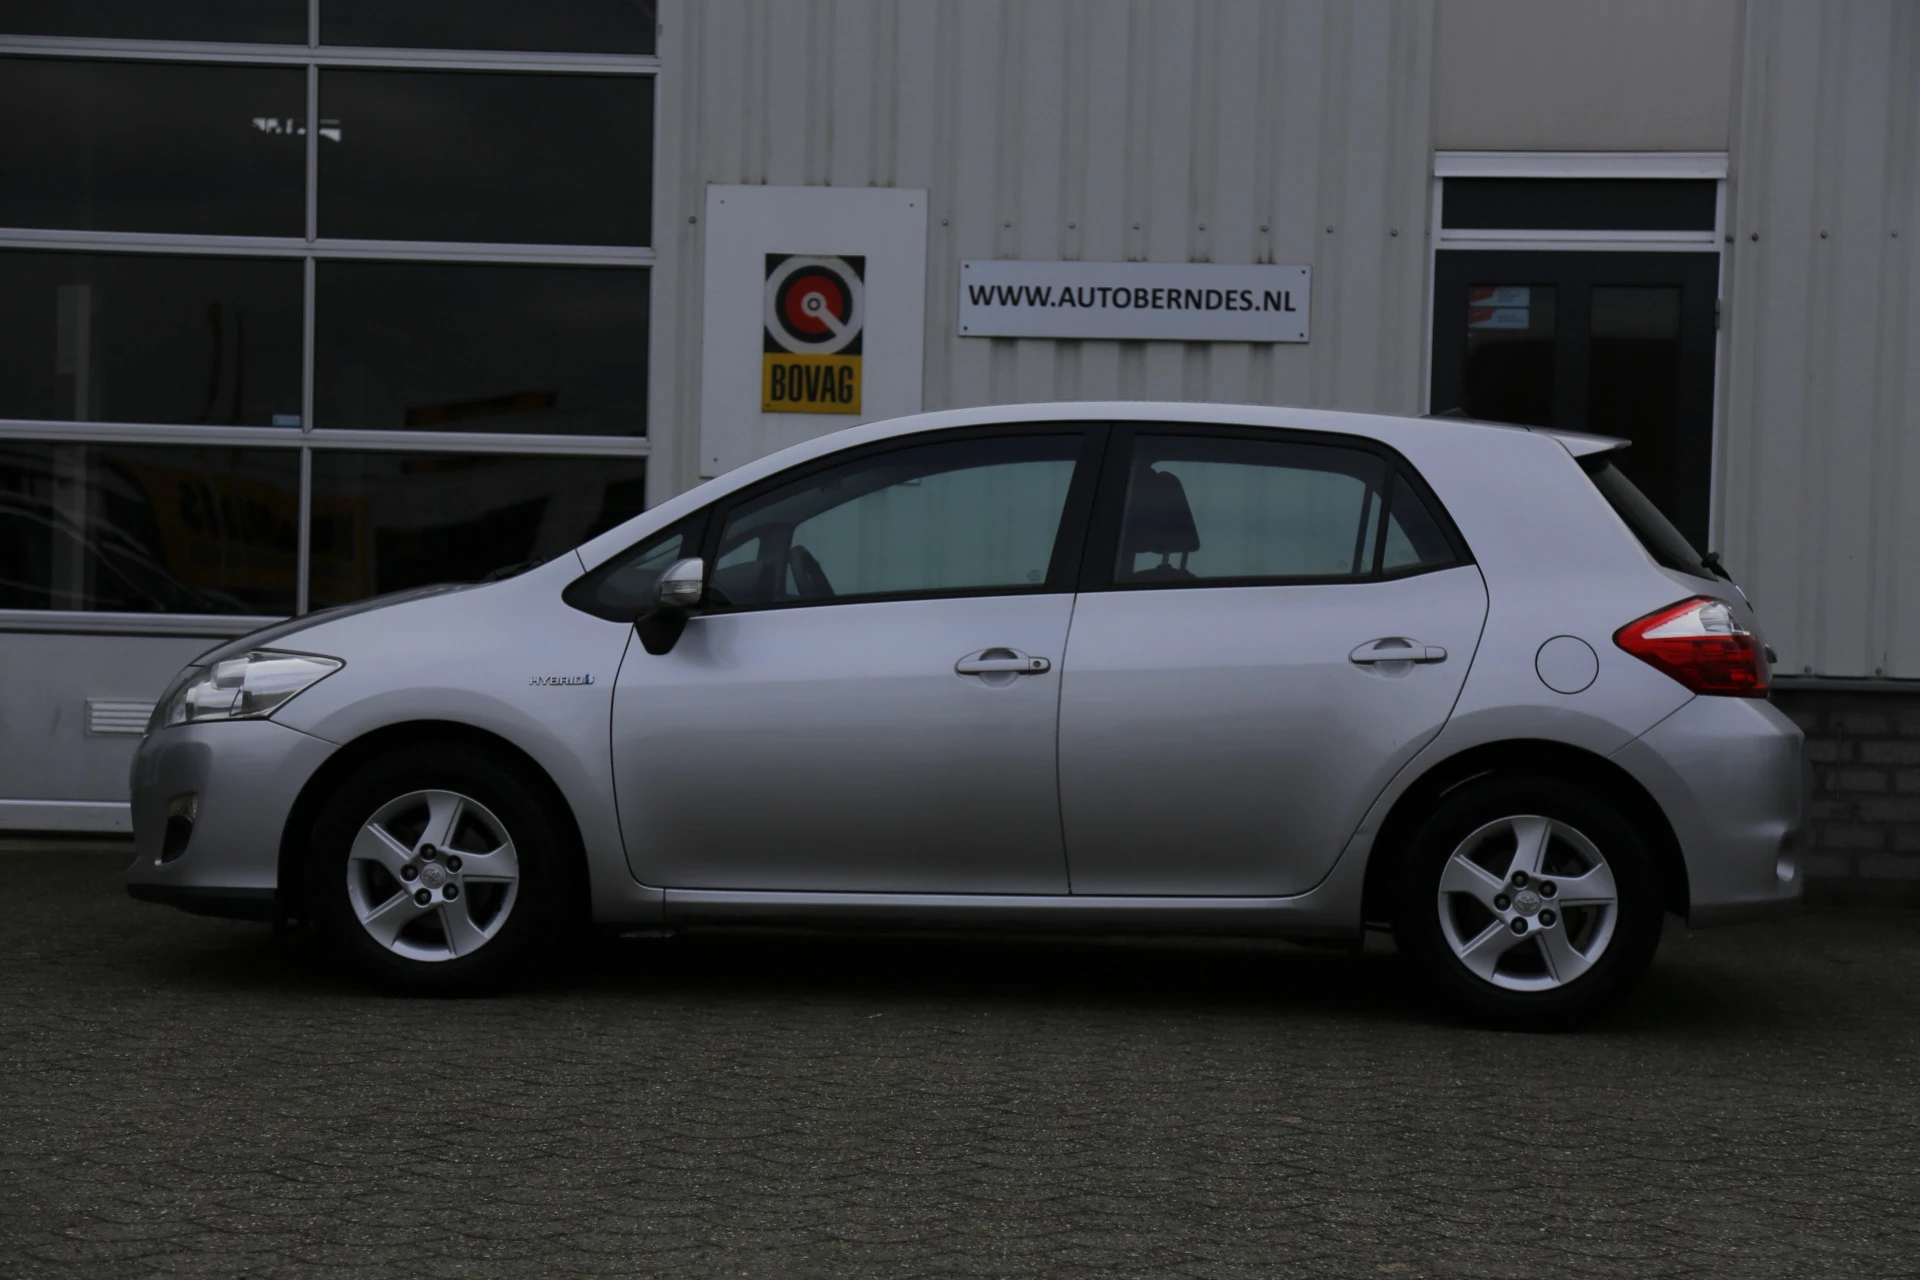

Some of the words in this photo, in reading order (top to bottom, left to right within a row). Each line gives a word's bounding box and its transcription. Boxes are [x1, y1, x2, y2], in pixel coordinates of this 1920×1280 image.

[968, 284, 1297, 312] WWW.AUTOBERNDES.NL
[771, 363, 854, 404] BOVAG
[529, 676, 585, 686] HYBRID
